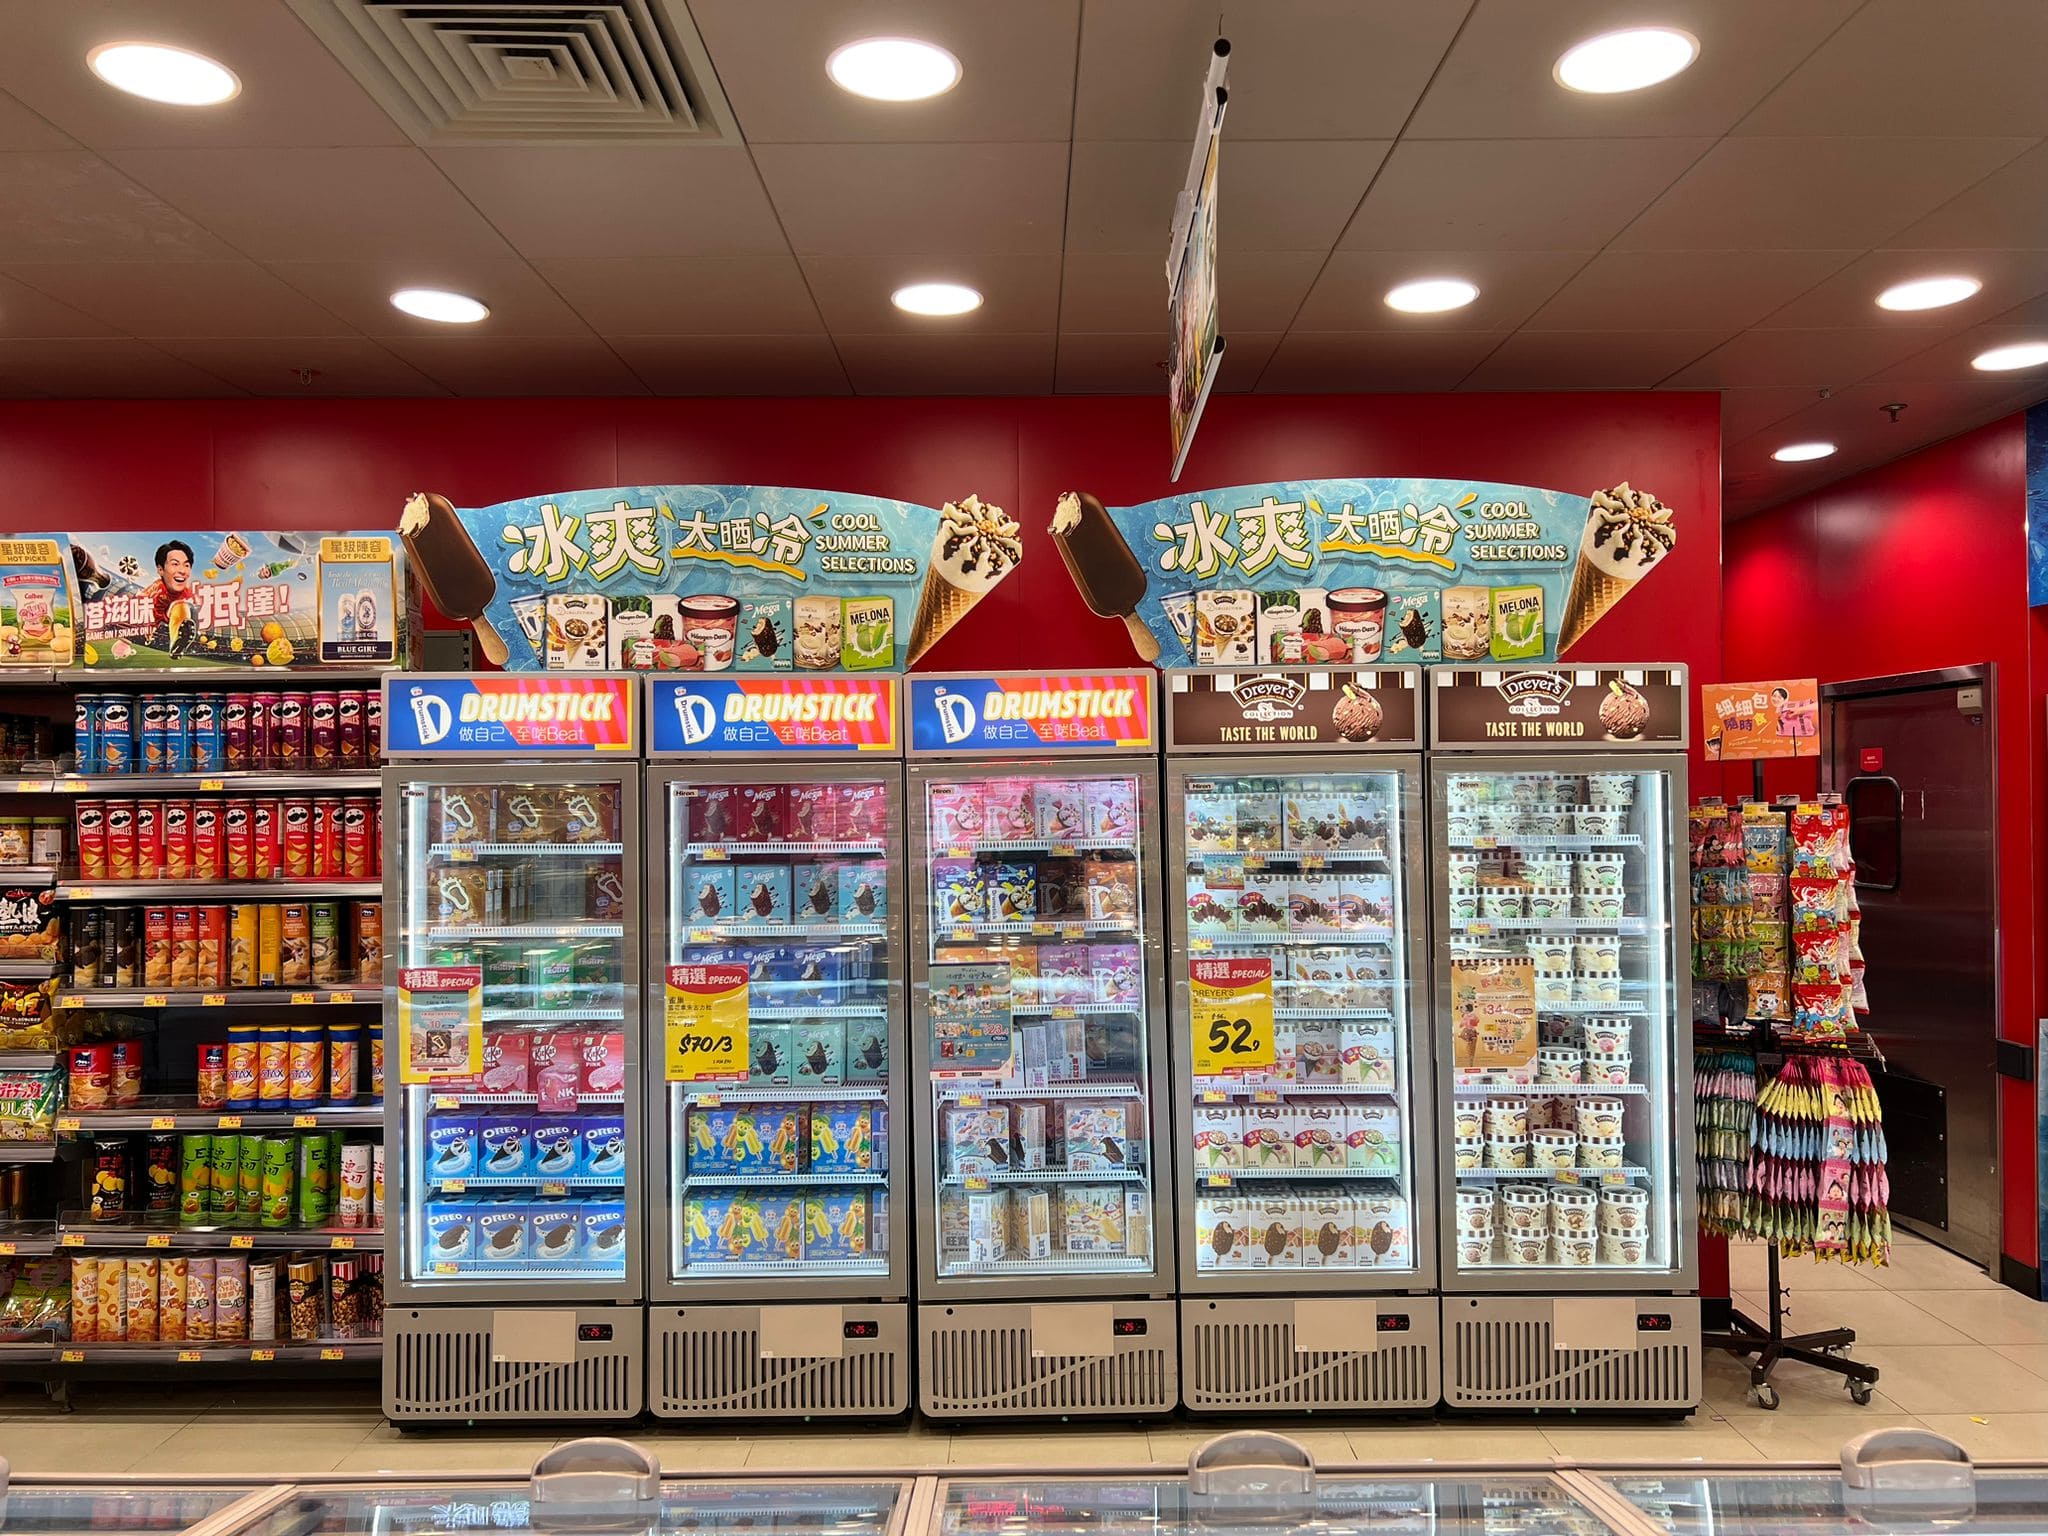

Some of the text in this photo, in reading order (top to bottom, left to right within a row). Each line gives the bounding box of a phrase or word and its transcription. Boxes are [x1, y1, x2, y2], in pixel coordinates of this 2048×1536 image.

[1479, 502, 1531, 519] COOL
[831, 513, 880, 532] COOL
[1153, 495, 1461, 580] 冰爽 大晒冷
[1464, 523, 1541, 541] SUMMER
[331, 541, 381, 553] 星級陣容
[503, 501, 811, 583] 冰爽 大晒冷
[815, 534, 890, 552] SUMMER
[1470, 545, 1567, 561] SELECTIONS
[820, 556, 917, 575] SELECTIONS
[1400, 593, 1428, 609] Mega
[1498, 597, 1539, 616] MELONA
[752, 603, 780, 619] Mega
[850, 608, 890, 626] MELONA
[1241, 682, 1296, 701] Dreyer's
[1507, 676, 1563, 696] Dreyer's
[458, 692, 617, 722] DRUMSTICK
[724, 692, 878, 722] DRUMSTICK
[983, 688, 1135, 721] DRUMSTICK
[104, 722, 128, 731] PRINGLES
[416, 699, 431, 741] Drumstick
[679, 700, 694, 740] Drumstick
[940, 699, 955, 739] Drumstick
[1220, 725, 1318, 741] TASTE THE WORLD
[1486, 721, 1584, 737] TASTE THE WORLD
[753, 788, 776, 802] Mega
[80, 826, 103, 836] PRINGLES
[109, 826, 132, 836] PRINGLES
[287, 823, 308, 833] PRINGLES
[672, 968, 742, 985] 精選 SPECIAL
[1196, 962, 1271, 979] 精選 SPECIAL
[404, 971, 474, 988] 精選 SPECIAL
[679, 1033, 733, 1055] $70/3
[229, 1069, 253, 1079] STAX
[262, 1069, 284, 1079] STAX
[290, 1069, 312, 1079] STAX
[430, 1126, 465, 1139] OREO
[483, 1126, 519, 1138] OREO
[534, 1126, 570, 1139] OREO
[585, 1127, 621, 1139] OREO
[427, 1213, 463, 1225] OREO
[480, 1213, 516, 1225] OREO
[533, 1213, 569, 1225] OREO
[585, 1213, 620, 1225] OREO
